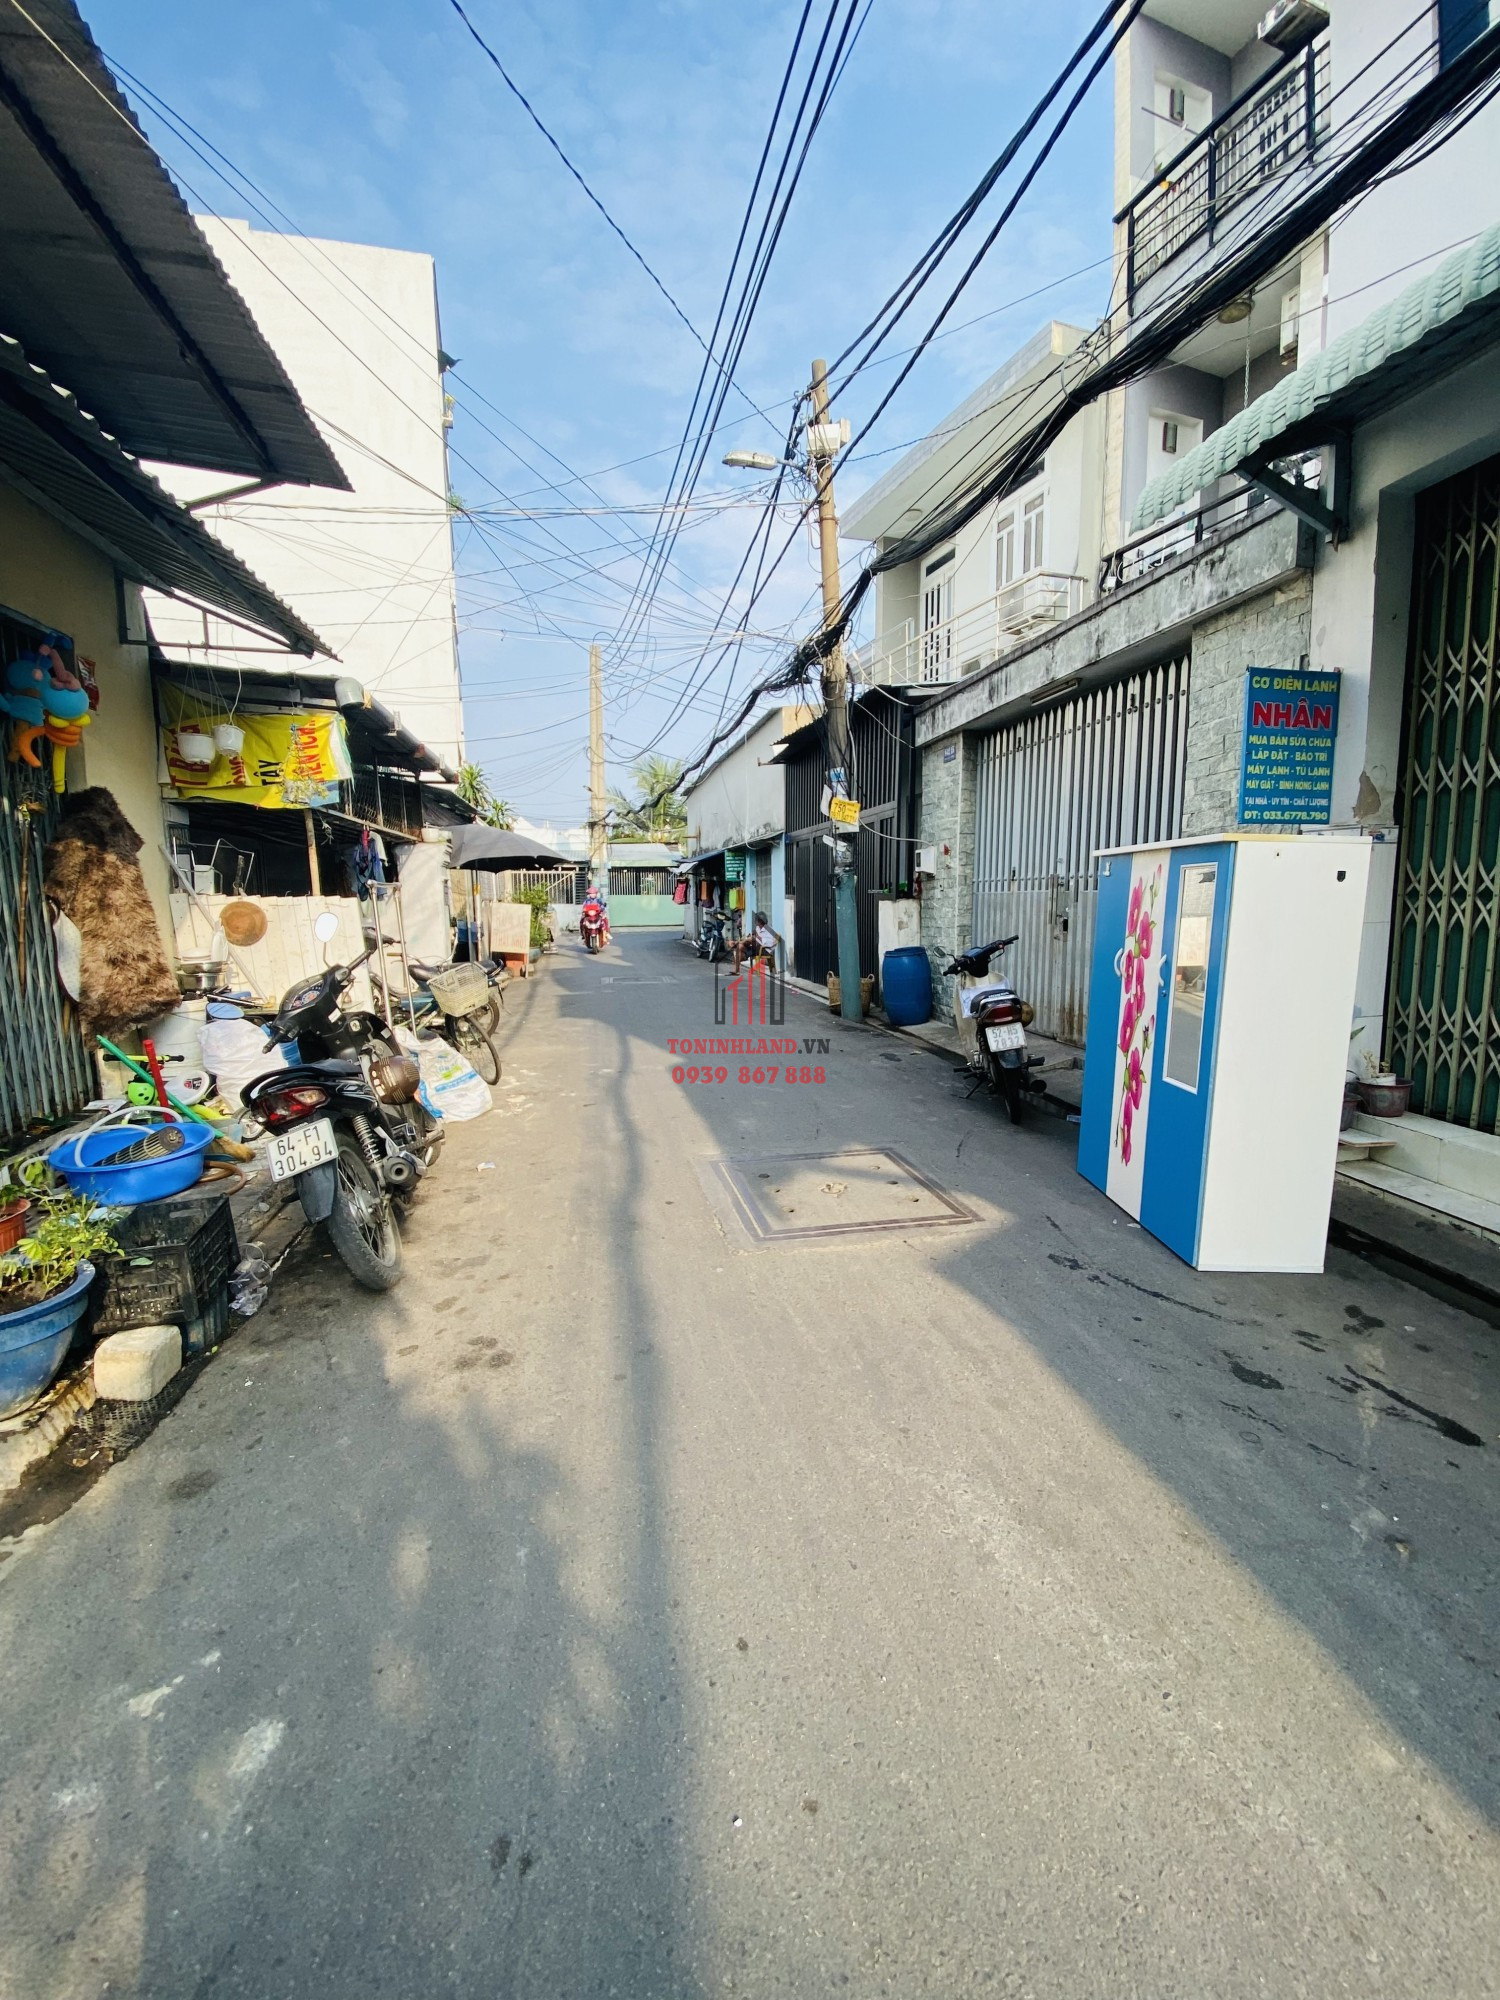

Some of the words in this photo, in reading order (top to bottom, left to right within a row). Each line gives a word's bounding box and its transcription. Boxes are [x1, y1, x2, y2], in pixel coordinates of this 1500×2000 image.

[1252, 676, 1270, 688] CƠ
[1273, 675, 1302, 694] ĐIỆN
[1304, 680, 1338, 695] LẠNH
[1252, 697, 1333, 730] NHÂN
[1248, 735, 1268, 745] MUA
[1270, 734, 1288, 746] BÁN
[1247, 763, 1265, 775] MÁY
[1267, 765, 1290, 778] LẠNH
[1308, 766, 1330, 779] LẠNH
[1244, 811, 1261, 820] ĐT:
[277, 1126, 320, 1156] 64-F1
[275, 1141, 332, 1176] 304.94
